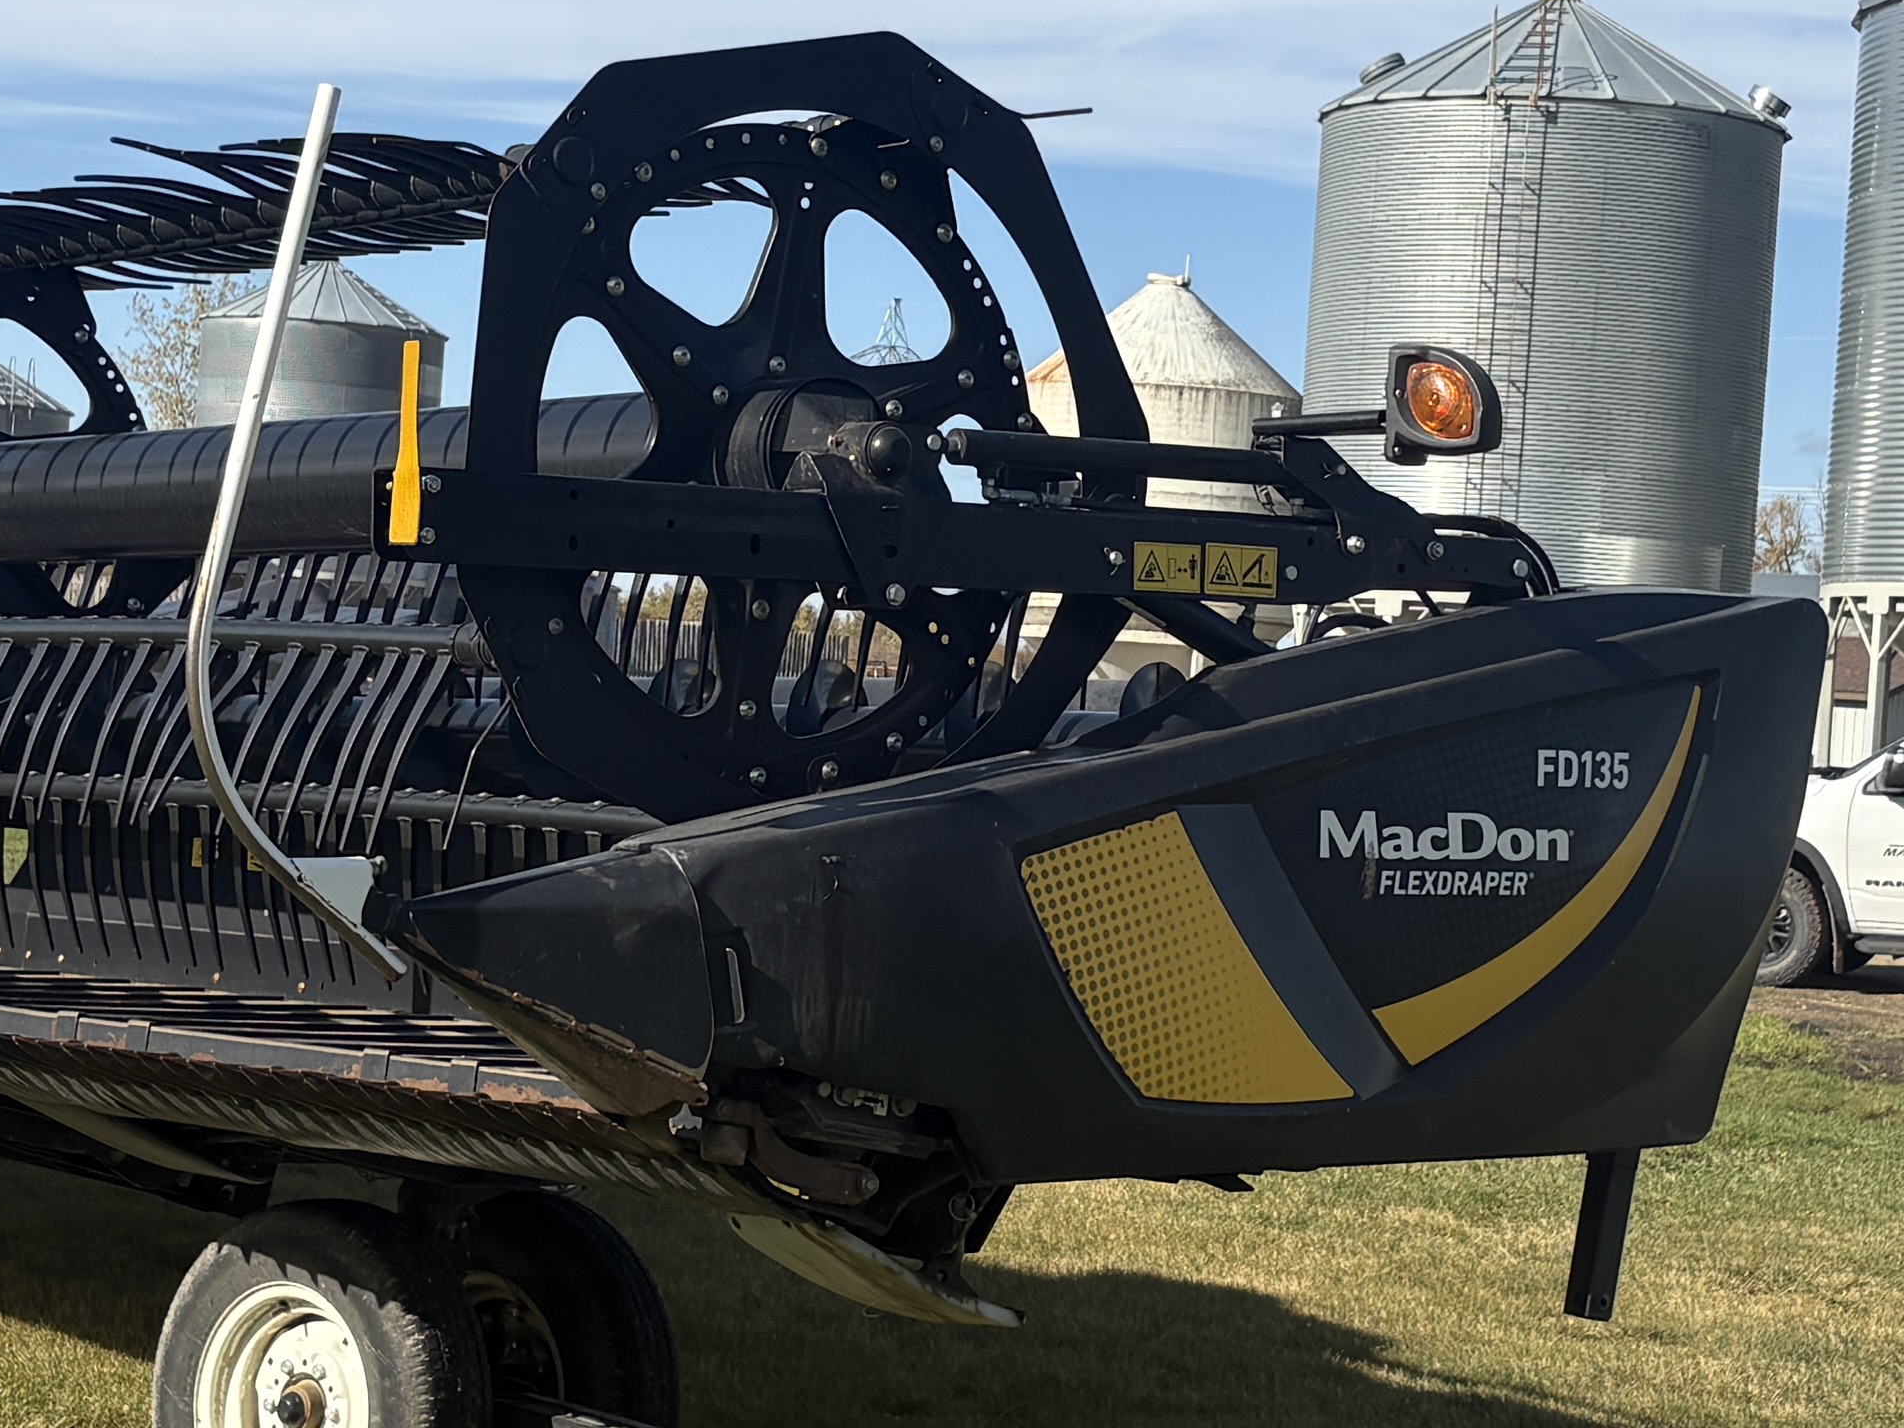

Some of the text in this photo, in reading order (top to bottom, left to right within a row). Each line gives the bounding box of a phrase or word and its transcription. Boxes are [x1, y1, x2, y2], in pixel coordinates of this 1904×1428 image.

[1537, 749, 1630, 789] FD135
[1319, 809, 1570, 861] MacDon
[1379, 870, 1528, 896] FLEXDRAPER
